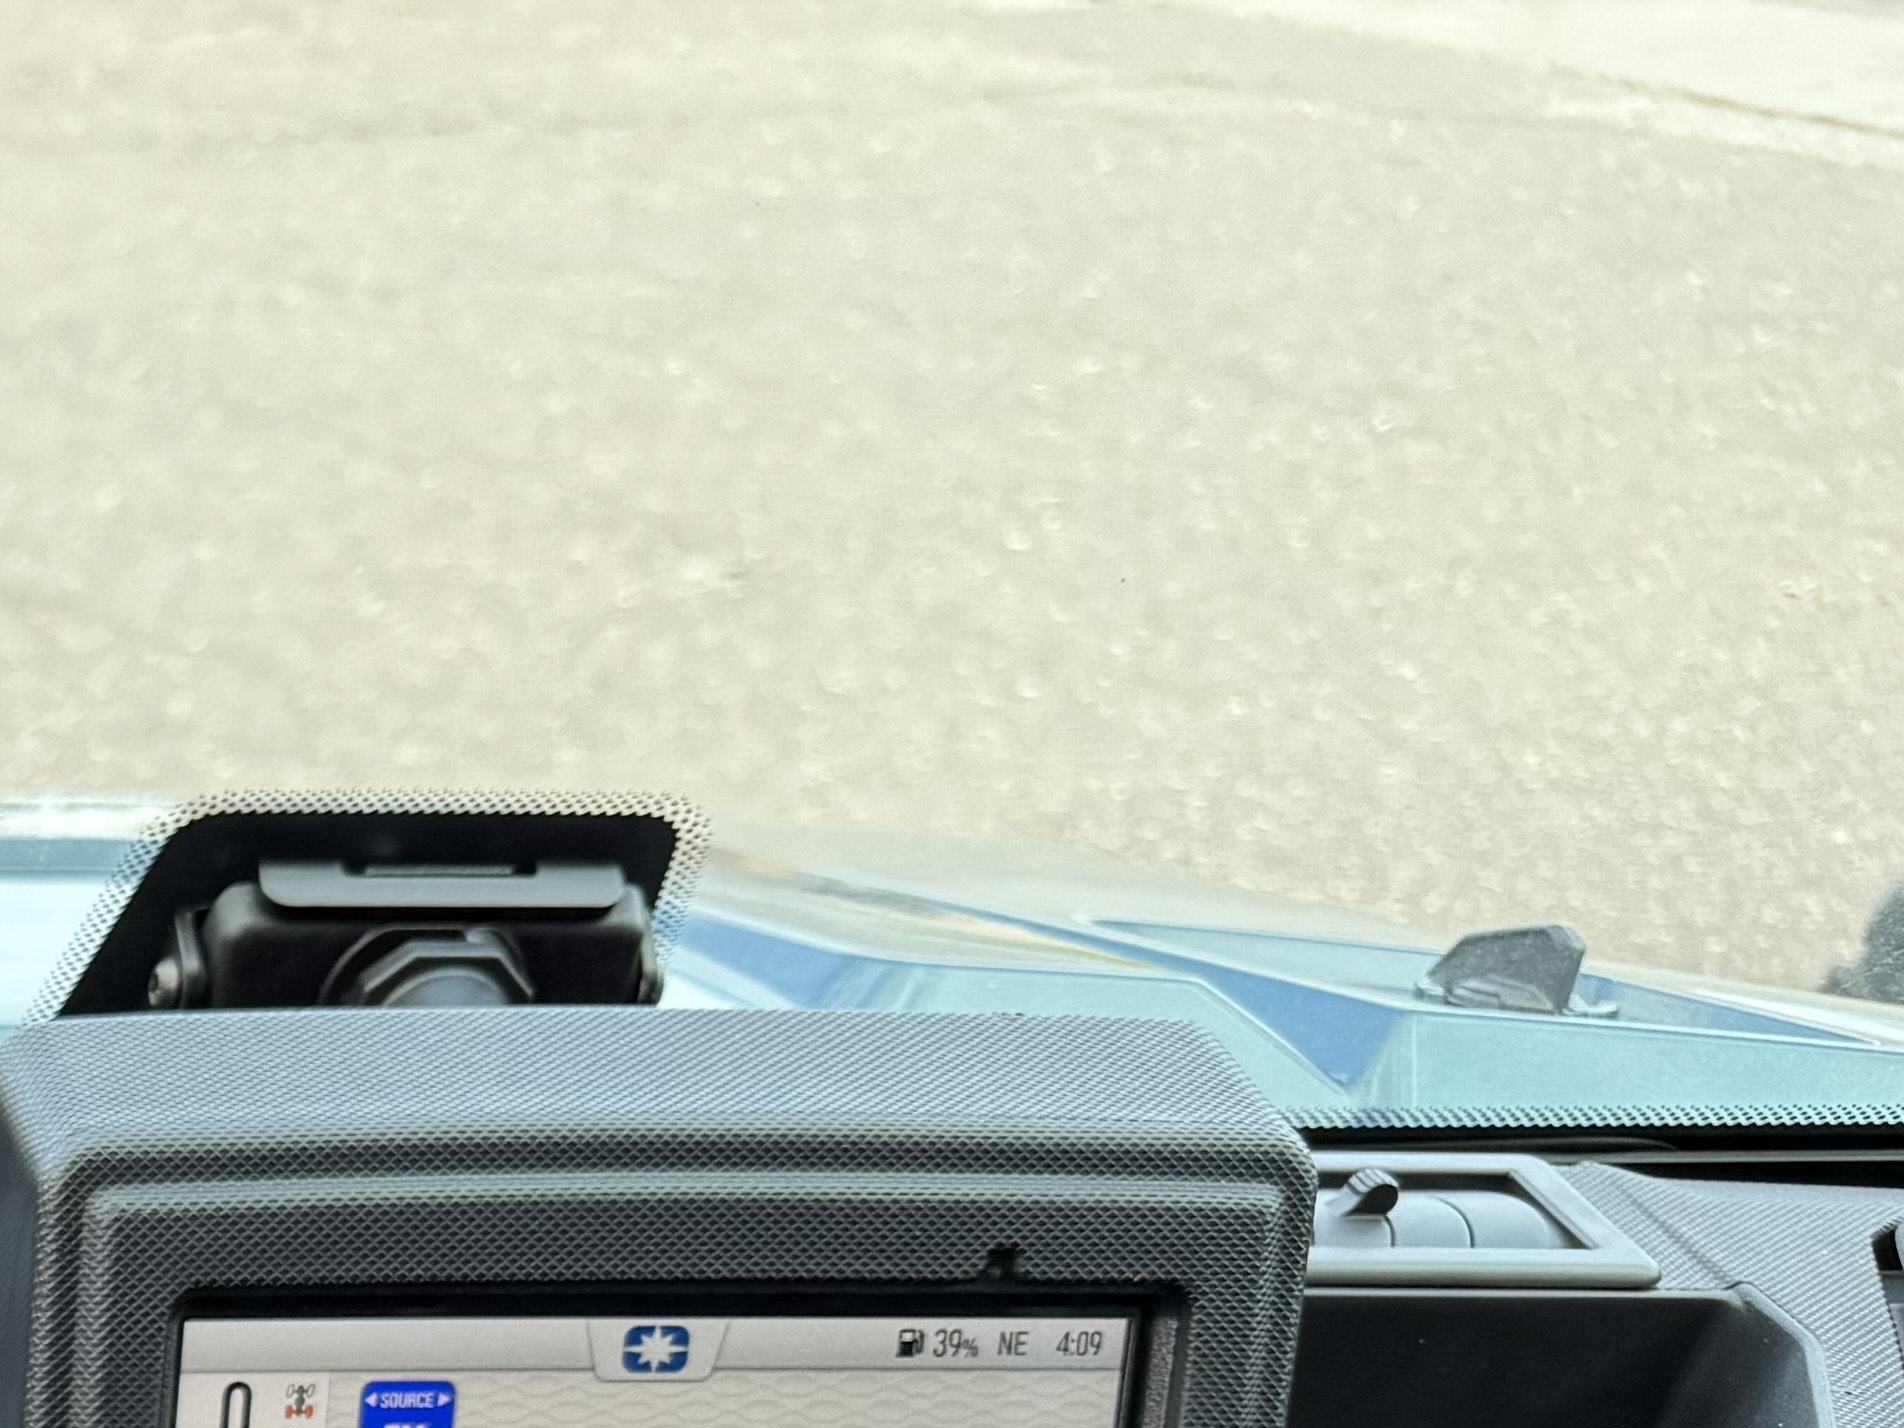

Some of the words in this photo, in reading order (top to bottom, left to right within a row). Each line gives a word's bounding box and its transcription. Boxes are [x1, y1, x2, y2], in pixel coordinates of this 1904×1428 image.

[933, 1328, 979, 1358] 39%
[997, 1331, 1029, 1356] NE
[1056, 1330, 1103, 1356] 4:09
[379, 1391, 435, 1410] SOURCE
